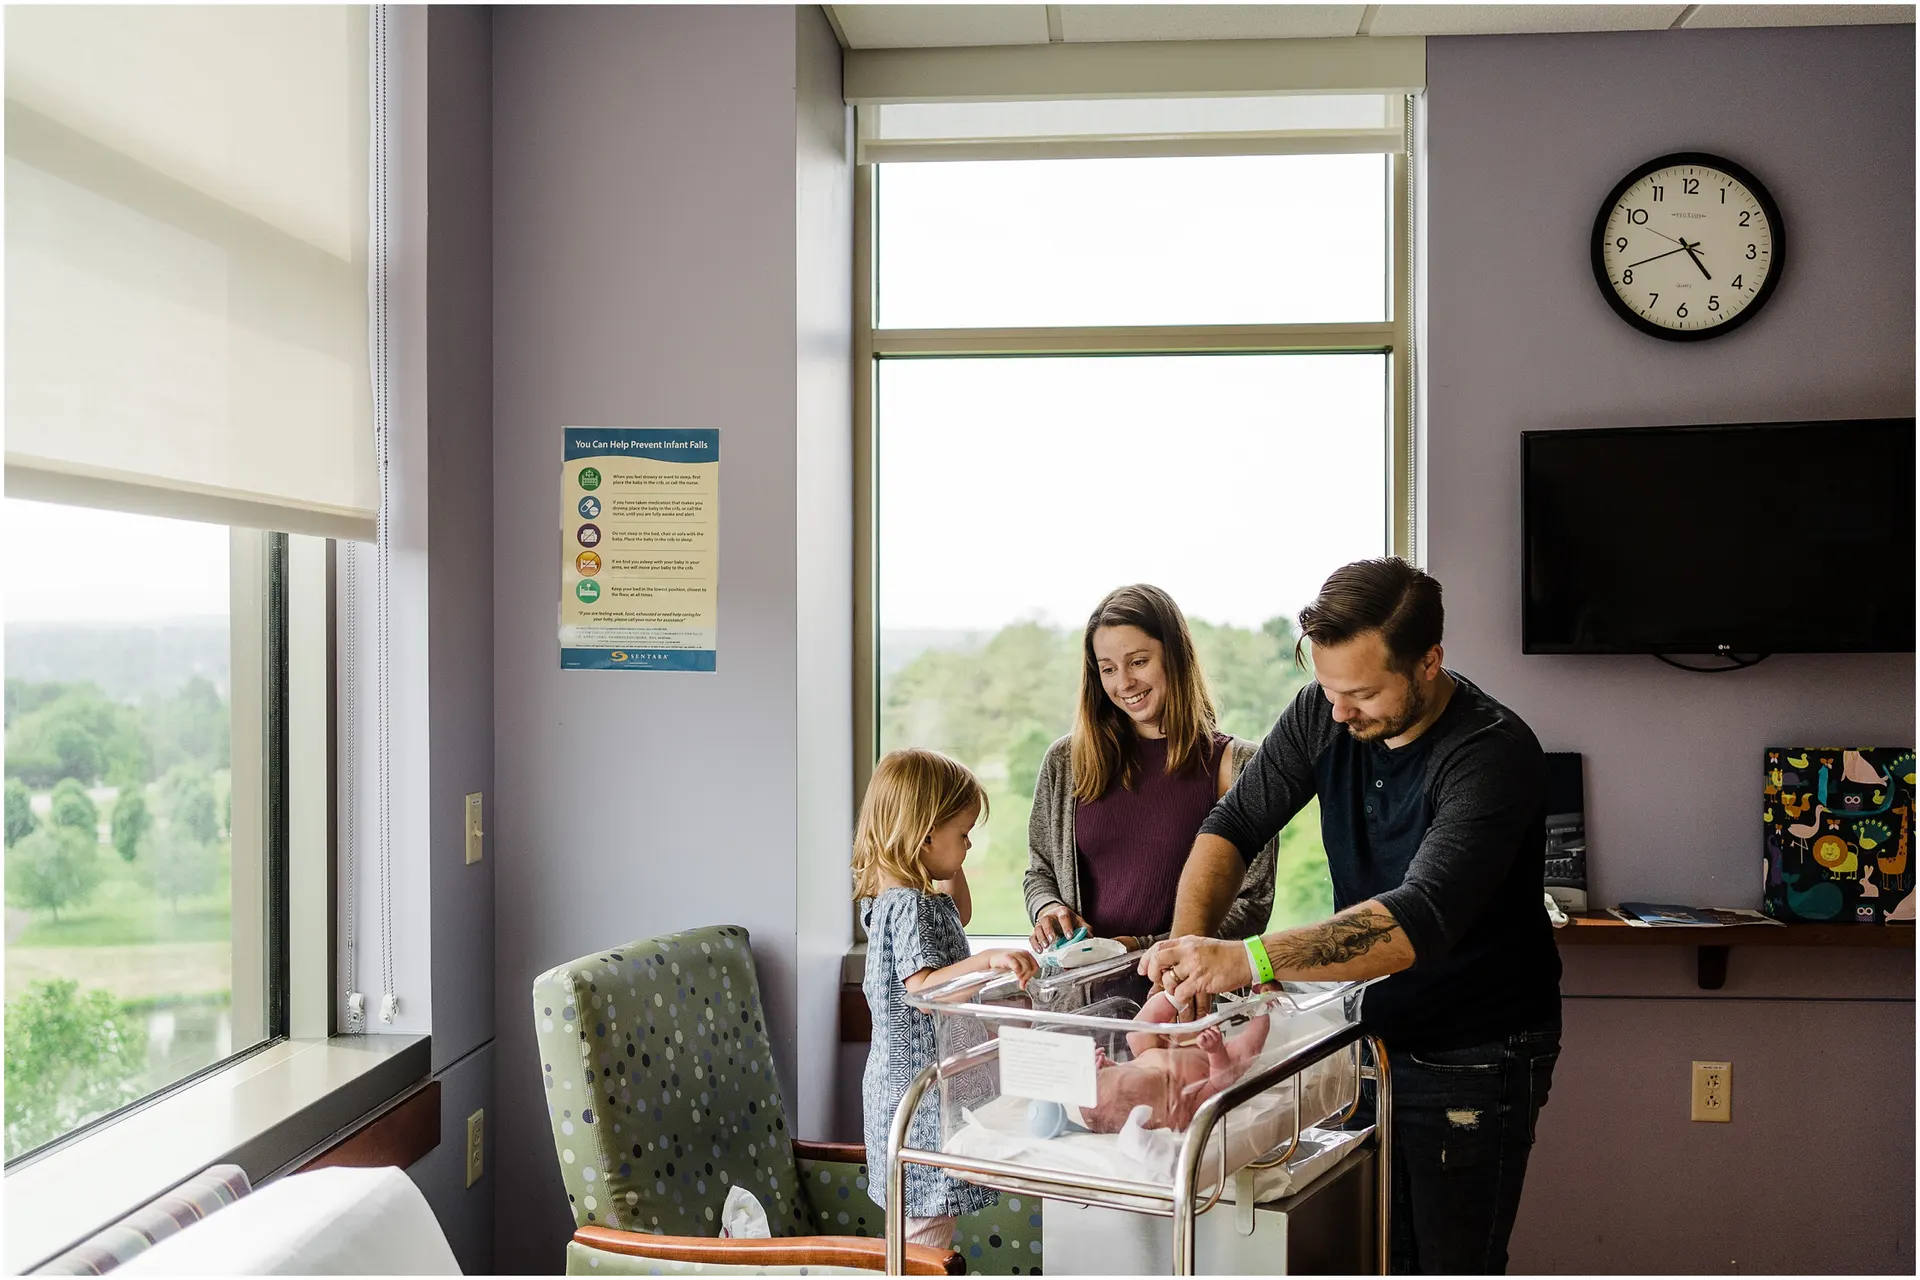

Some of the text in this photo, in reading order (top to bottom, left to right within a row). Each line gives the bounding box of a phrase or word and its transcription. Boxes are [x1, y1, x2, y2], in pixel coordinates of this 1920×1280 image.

[1652, 186, 1663, 201] 11
[1683, 179, 1699, 194] 12
[1720, 189, 1725, 204] 1
[1626, 209, 1648, 224] 10
[1739, 211, 1750, 227] 2
[1616, 237, 1628, 252] 9
[1746, 244, 1756, 259] 3
[1623, 269, 1633, 284] 8
[1731, 275, 1743, 289] 4
[1649, 293, 1659, 308] 7
[1708, 296, 1719, 311] 5
[1677, 303, 1688, 318] 6
[610, 441, 629, 450] Help
